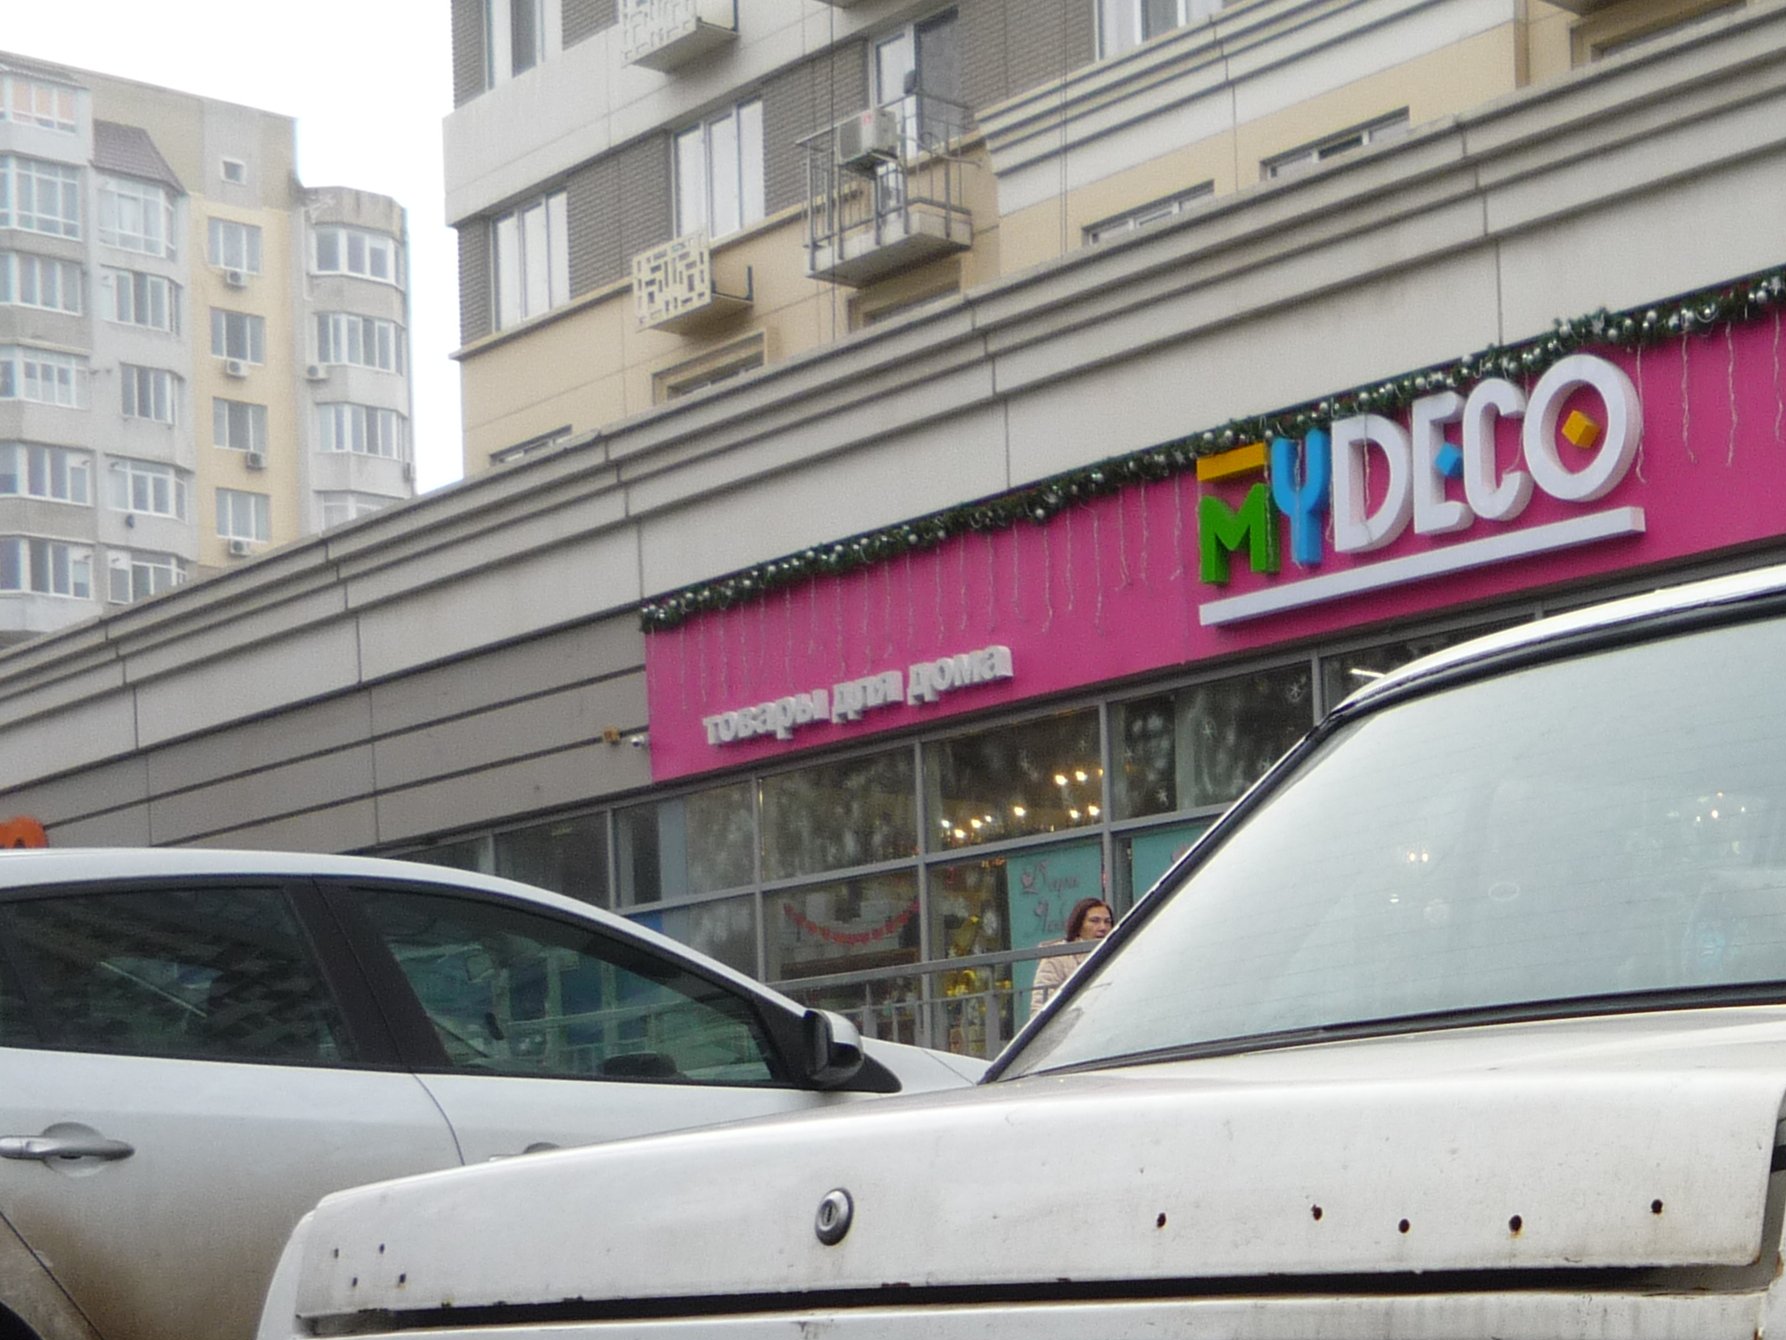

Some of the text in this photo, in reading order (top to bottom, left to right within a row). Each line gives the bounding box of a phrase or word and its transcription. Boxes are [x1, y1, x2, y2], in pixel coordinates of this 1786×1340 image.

[703, 645, 1013, 745] товары для дома
